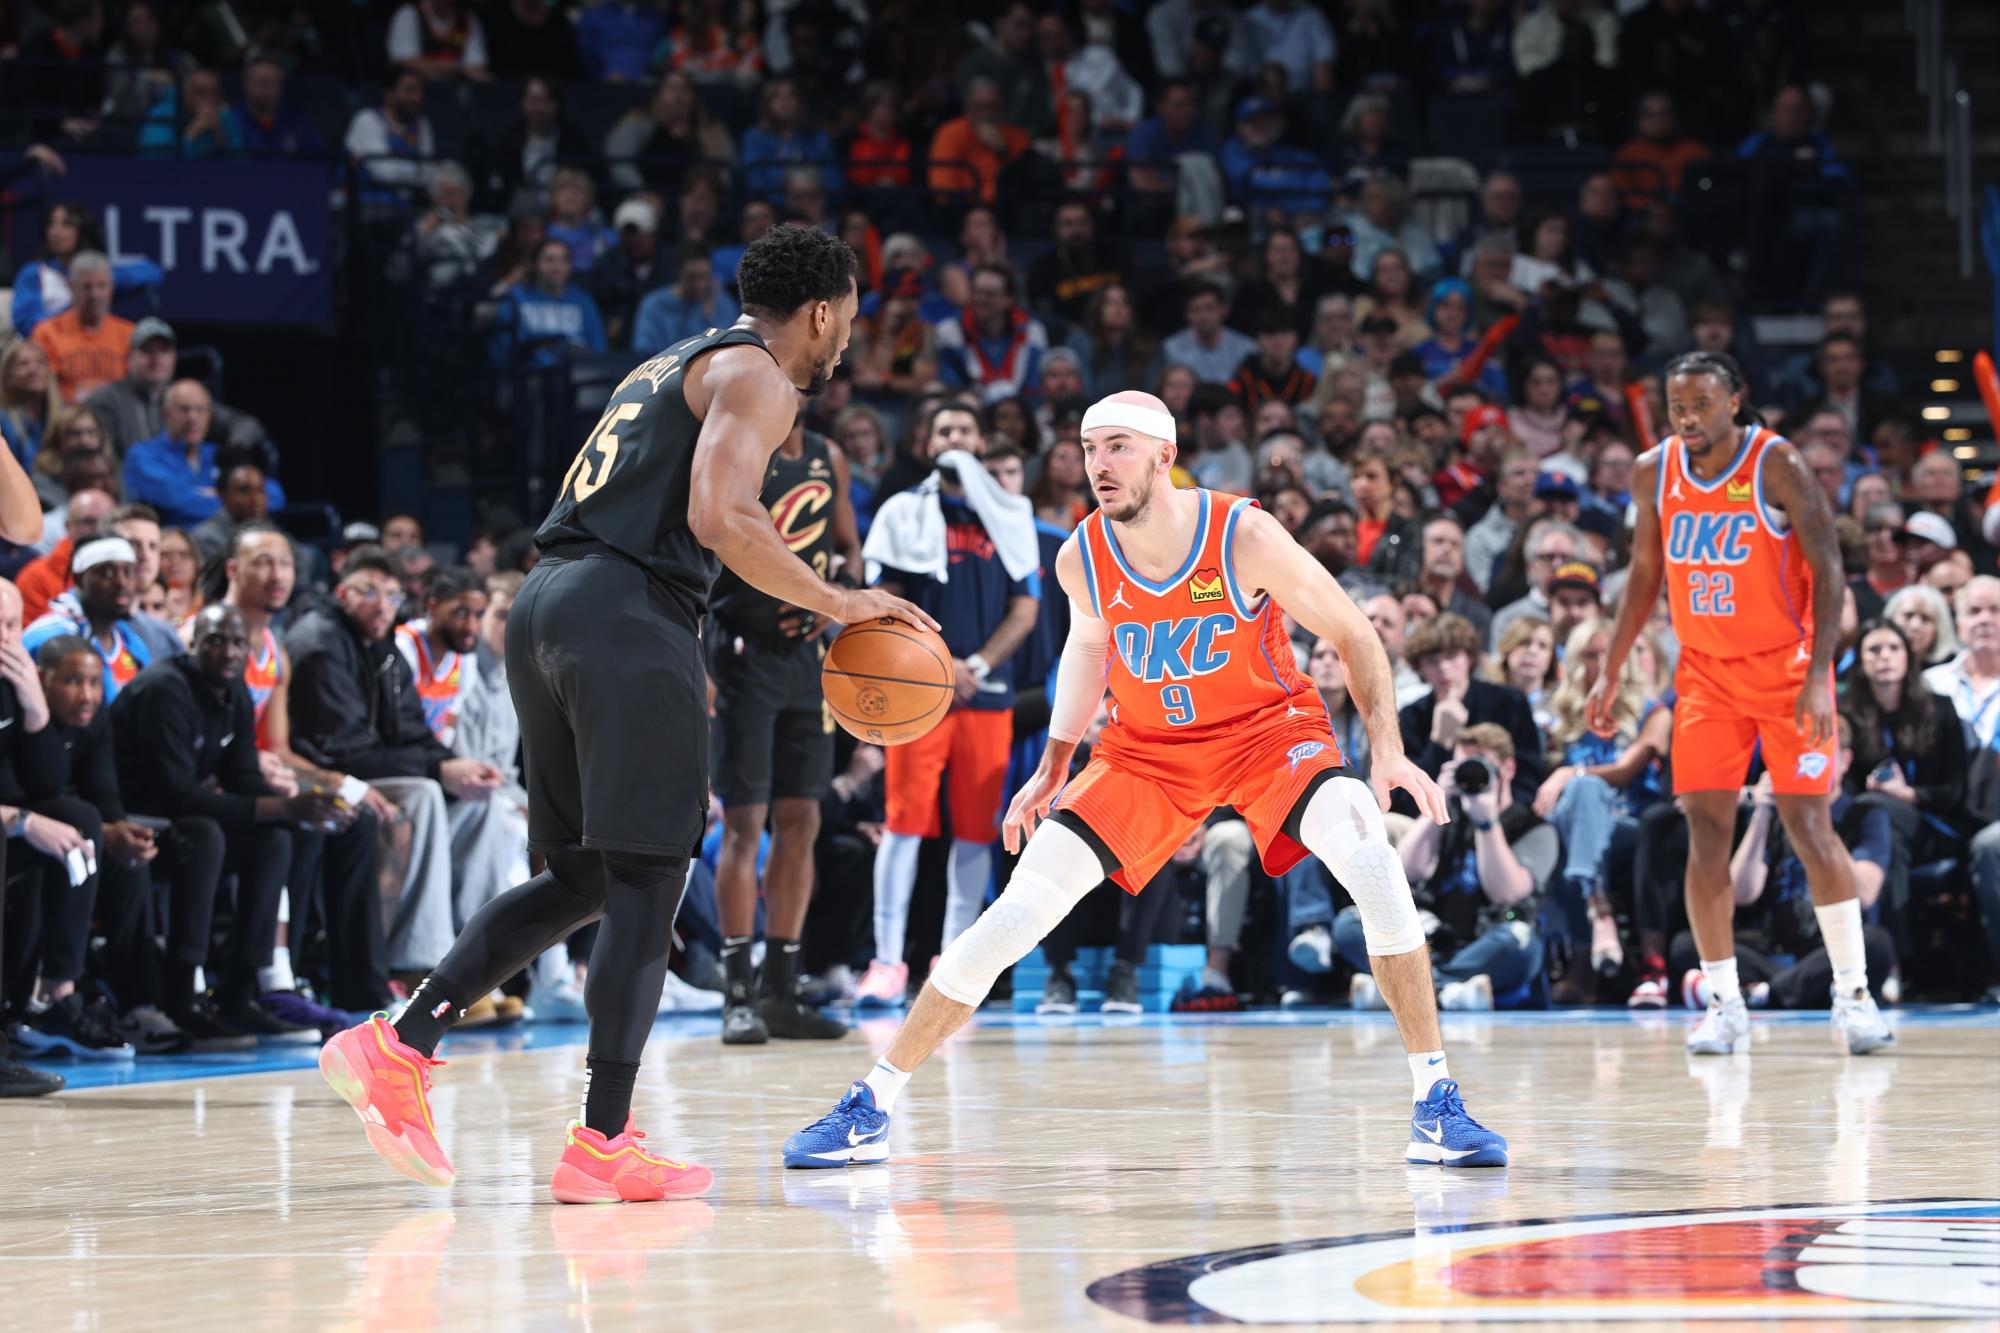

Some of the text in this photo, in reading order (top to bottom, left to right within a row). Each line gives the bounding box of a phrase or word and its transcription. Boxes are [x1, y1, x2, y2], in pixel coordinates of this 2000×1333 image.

[103, 204, 309, 275] LTRA
[1666, 510, 1757, 565] OKC
[1688, 570, 1735, 616] 22
[1114, 613, 1236, 682] OKC
[1160, 684, 1196, 725] 9
